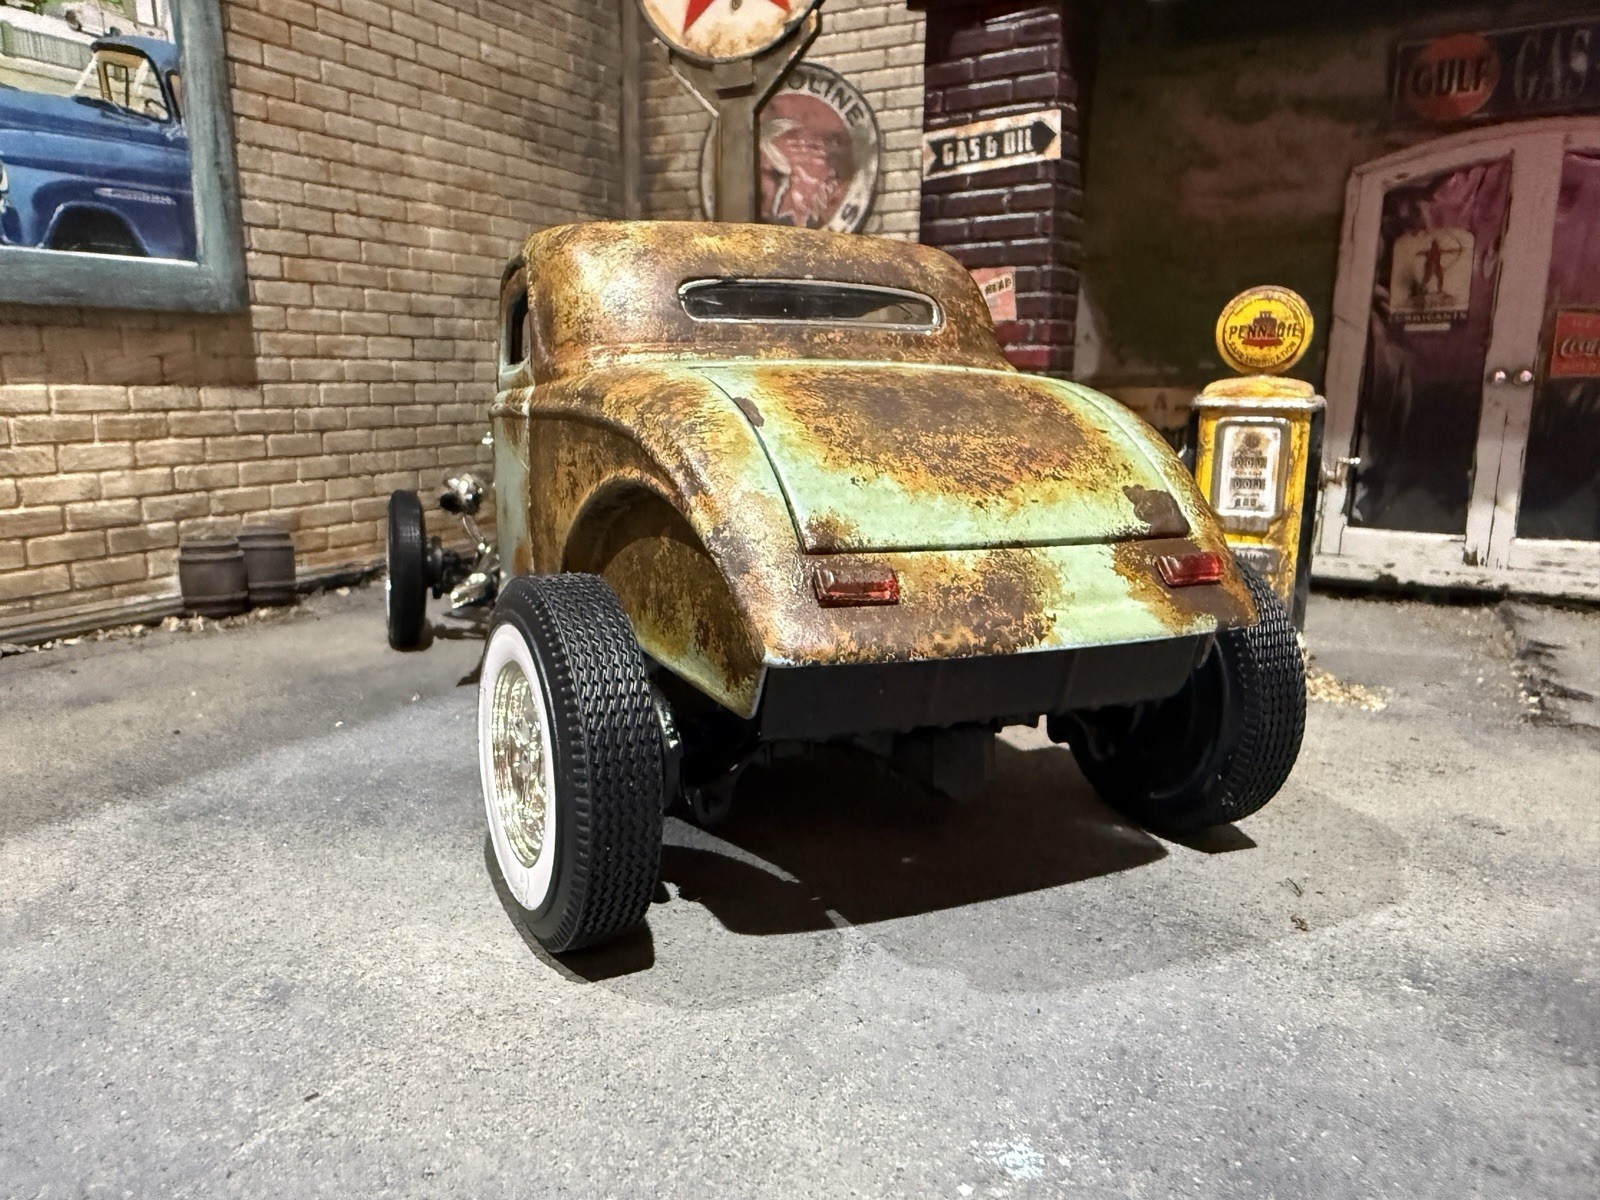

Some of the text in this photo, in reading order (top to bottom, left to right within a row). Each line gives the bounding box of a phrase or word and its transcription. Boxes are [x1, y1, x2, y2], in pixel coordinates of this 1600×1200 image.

[1410, 56, 1487, 95] GULF
[942, 138, 980, 166] GAS
[1003, 128, 1034, 155] OIL
